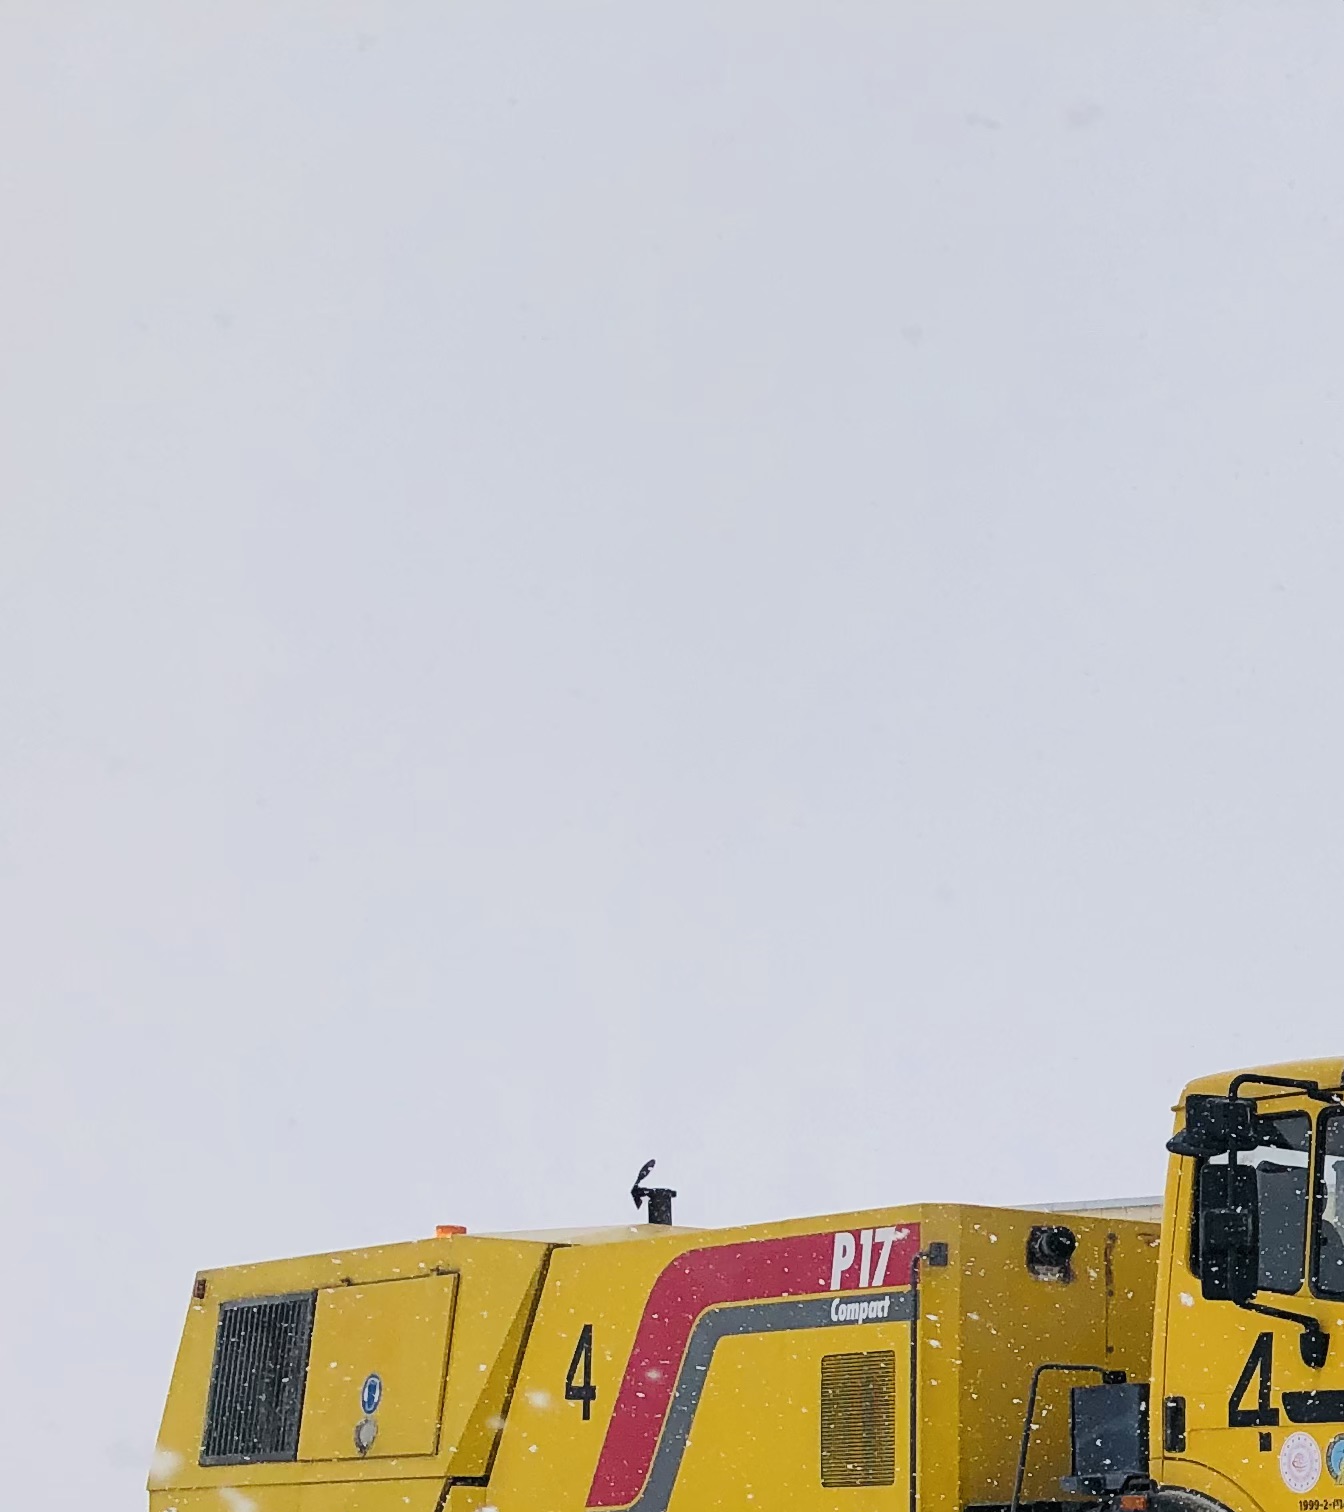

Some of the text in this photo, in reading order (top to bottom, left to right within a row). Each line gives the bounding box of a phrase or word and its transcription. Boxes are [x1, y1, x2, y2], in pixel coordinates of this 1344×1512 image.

[831, 1296, 890, 1324] Compact
[565, 1323, 596, 1420] 4
[1229, 1332, 1279, 1451] 4
